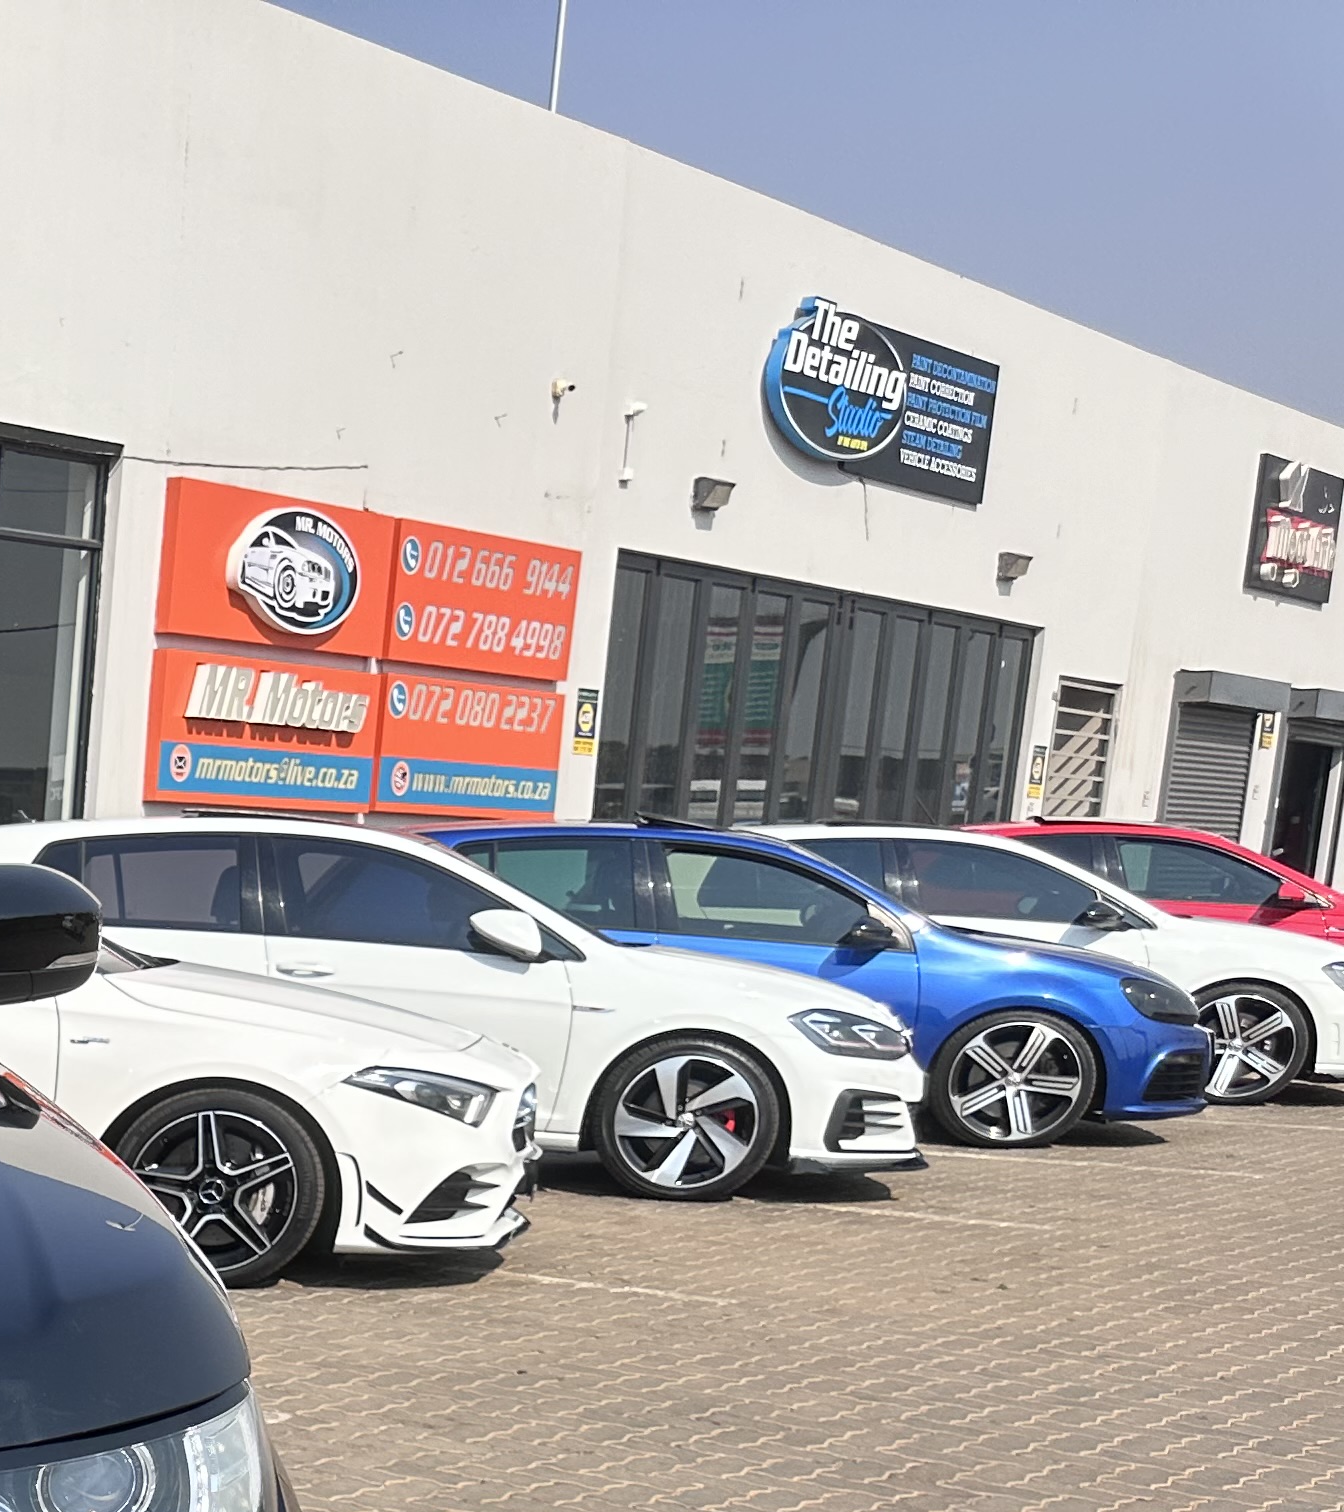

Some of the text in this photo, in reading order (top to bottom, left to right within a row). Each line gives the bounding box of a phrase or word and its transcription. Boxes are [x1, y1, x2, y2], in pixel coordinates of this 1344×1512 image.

[811, 297, 860, 351] The
[783, 329, 907, 411] Detailing
[823, 385, 892, 438] Studio
[295, 515, 355, 573] MR. MOTORS
[424, 541, 575, 600] 012 666 9144
[417, 604, 567, 660] 072 788 4998
[185, 663, 370, 733] MR. Motors
[408, 683, 557, 734] 072 080 2237
[194, 757, 359, 790] mrmotors@live.co.za
[412, 772, 552, 801] www.mrmotors.co.za
